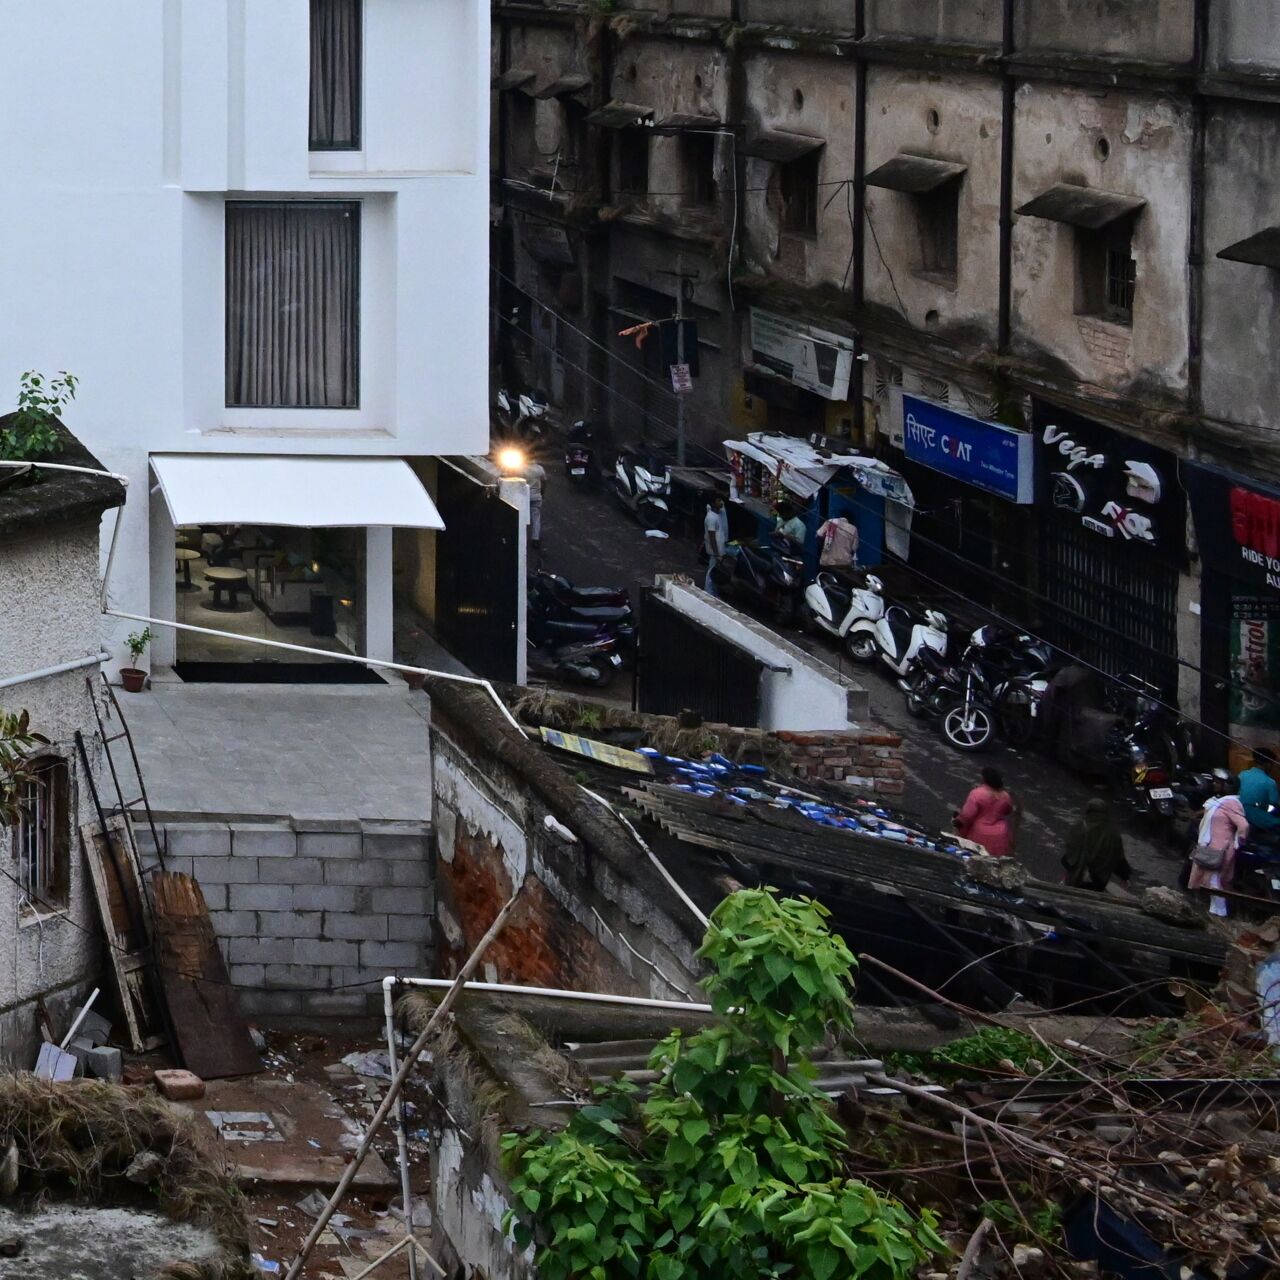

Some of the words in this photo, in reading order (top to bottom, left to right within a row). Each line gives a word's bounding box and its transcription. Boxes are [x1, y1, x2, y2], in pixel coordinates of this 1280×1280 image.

[906, 413, 936, 449] सिएट
[941, 435, 972, 462] CEAT
[1242, 546, 1265, 567] RIDE
